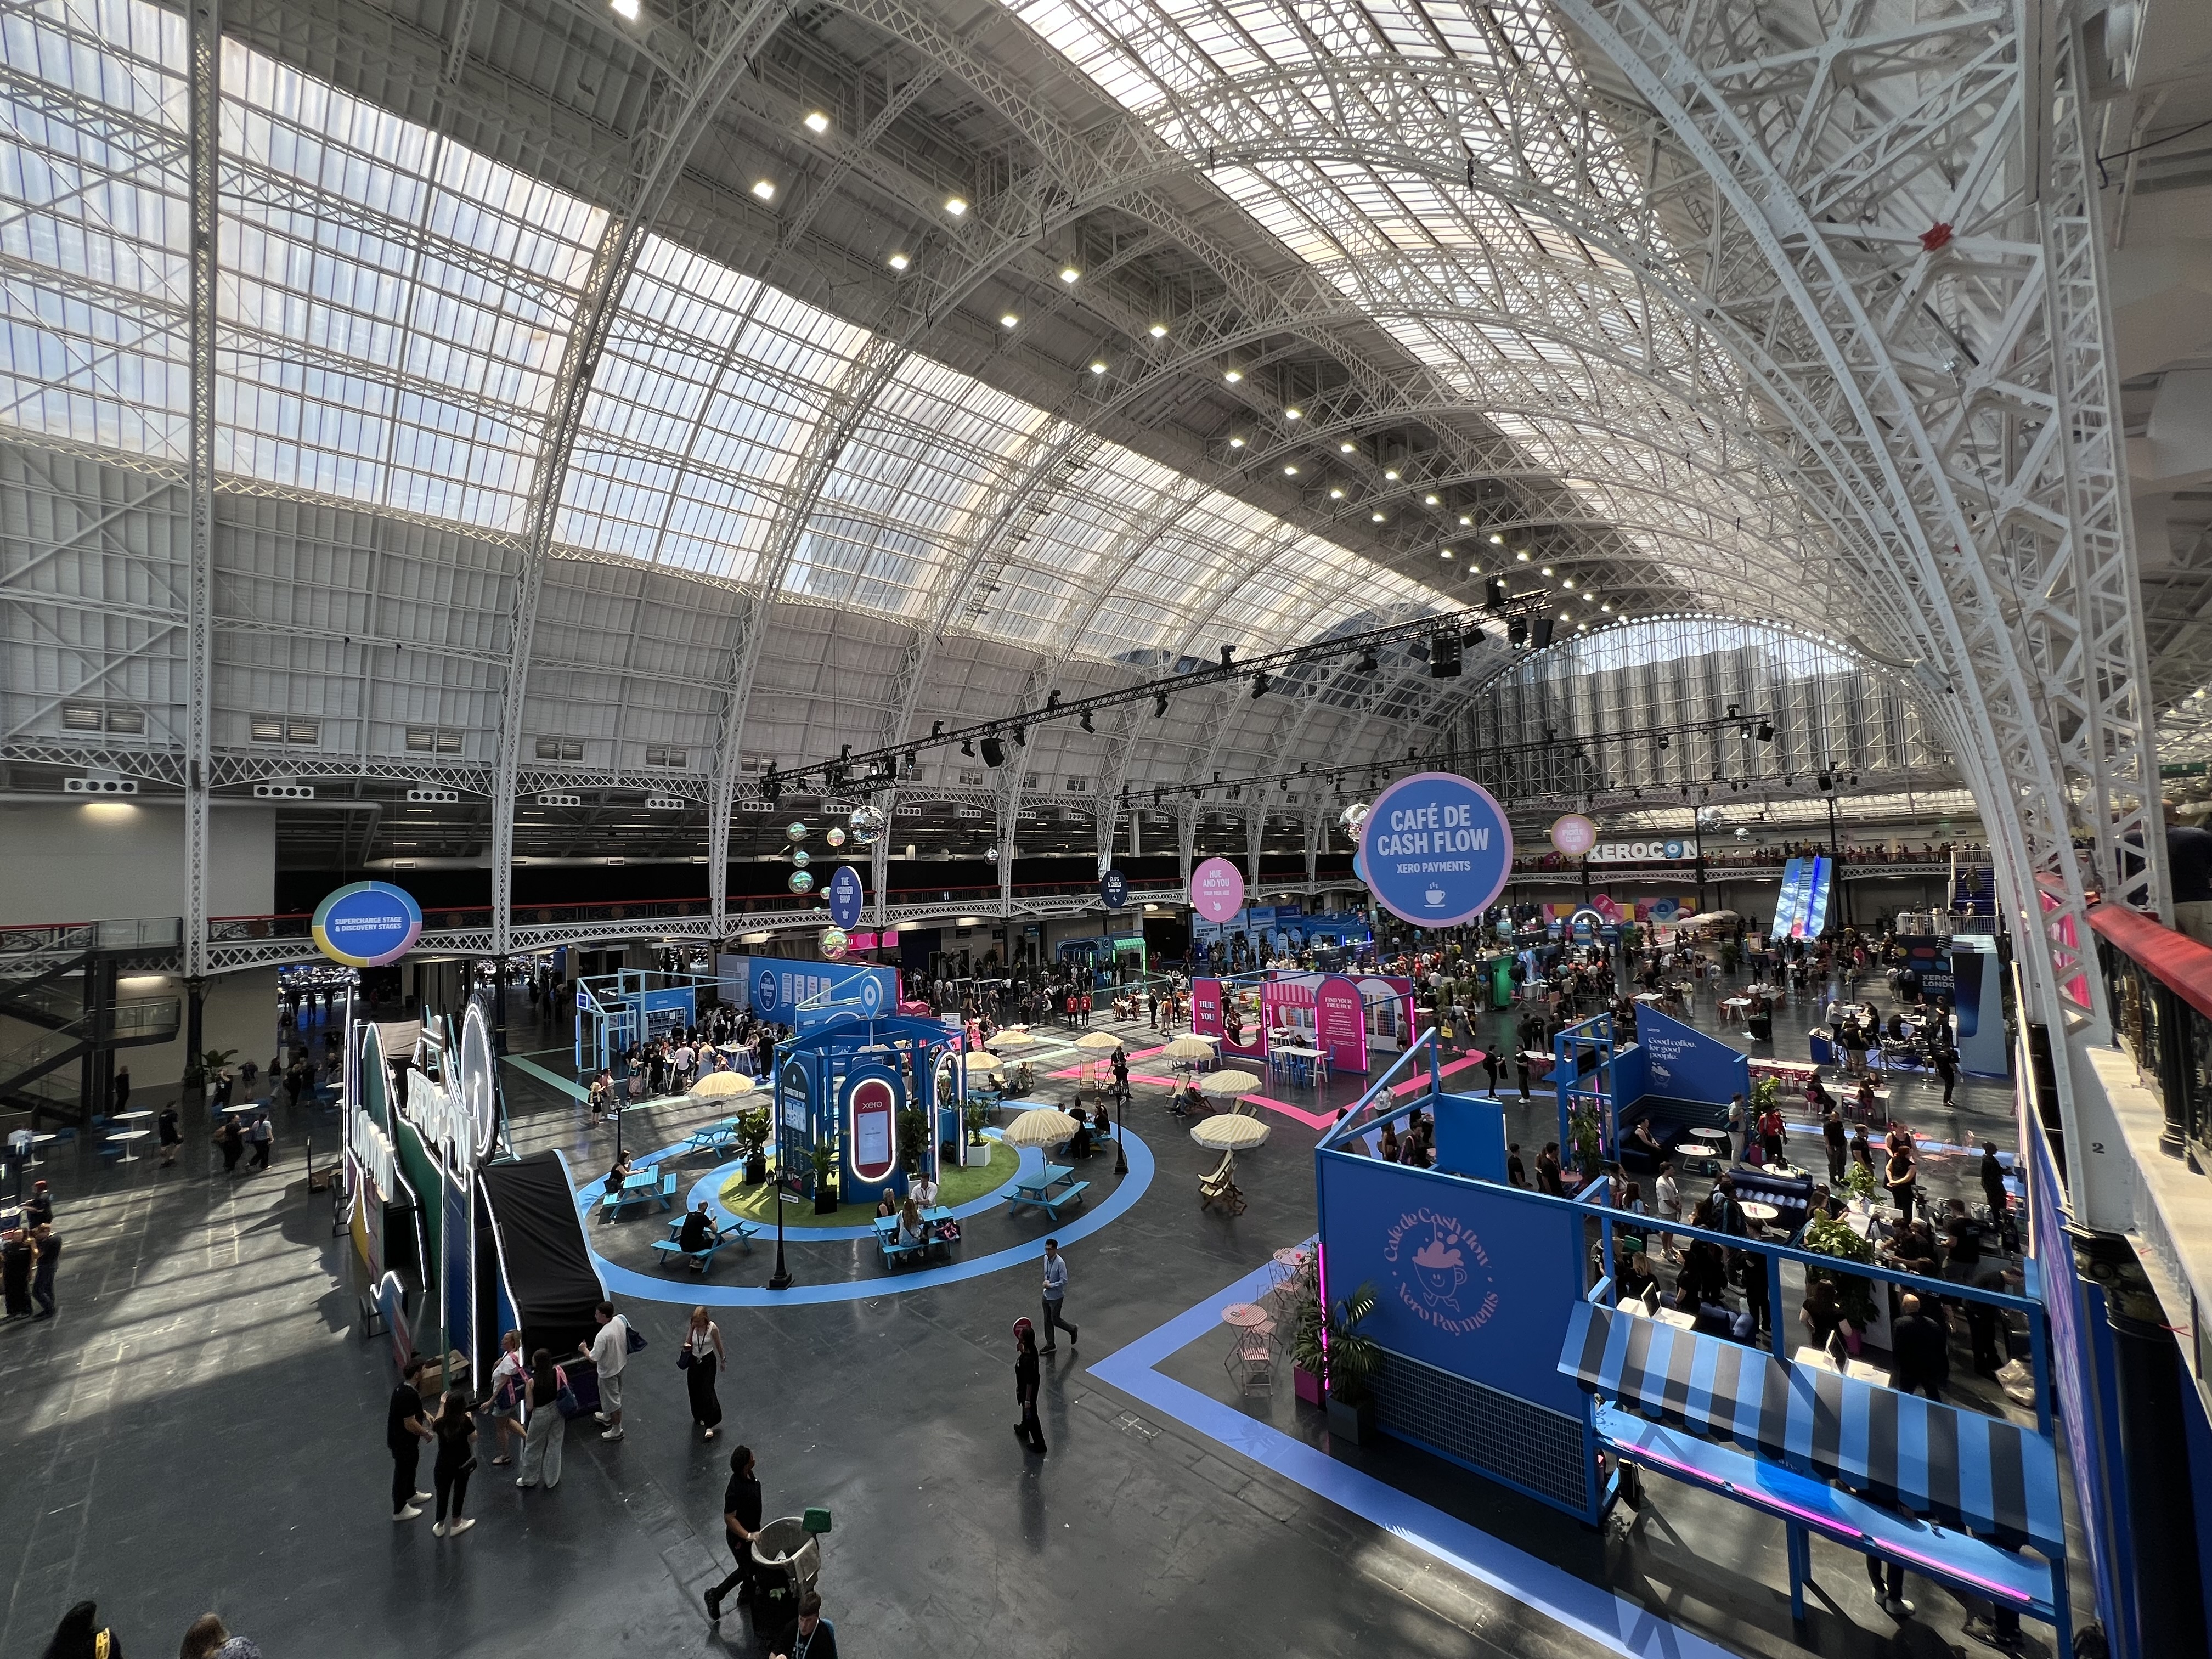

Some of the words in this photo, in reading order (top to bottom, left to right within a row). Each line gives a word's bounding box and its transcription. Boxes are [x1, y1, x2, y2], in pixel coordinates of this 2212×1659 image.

[1390, 802, 1439, 831] CAFÉ
[1443, 804, 1471, 827] DE
[1377, 832, 1429, 856] CASH
[1433, 828, 1489, 853] FLOW
[1396, 862, 1420, 873] XERO
[1422, 860, 1471, 873] PAYMENTS
[1209, 870, 1222, 878] HUE
[1203, 879, 1216, 887] AND
[1217, 878, 1230, 887] YOU
[1199, 1001, 1215, 1009] HUE
[1648, 1036, 1669, 1045] Good
[2091, 1142, 2105, 1154] 2
[1400, 1213, 1418, 1229] de
[1418, 1207, 1462, 1235] Cash
[1432, 1291, 1499, 1336] Payments
